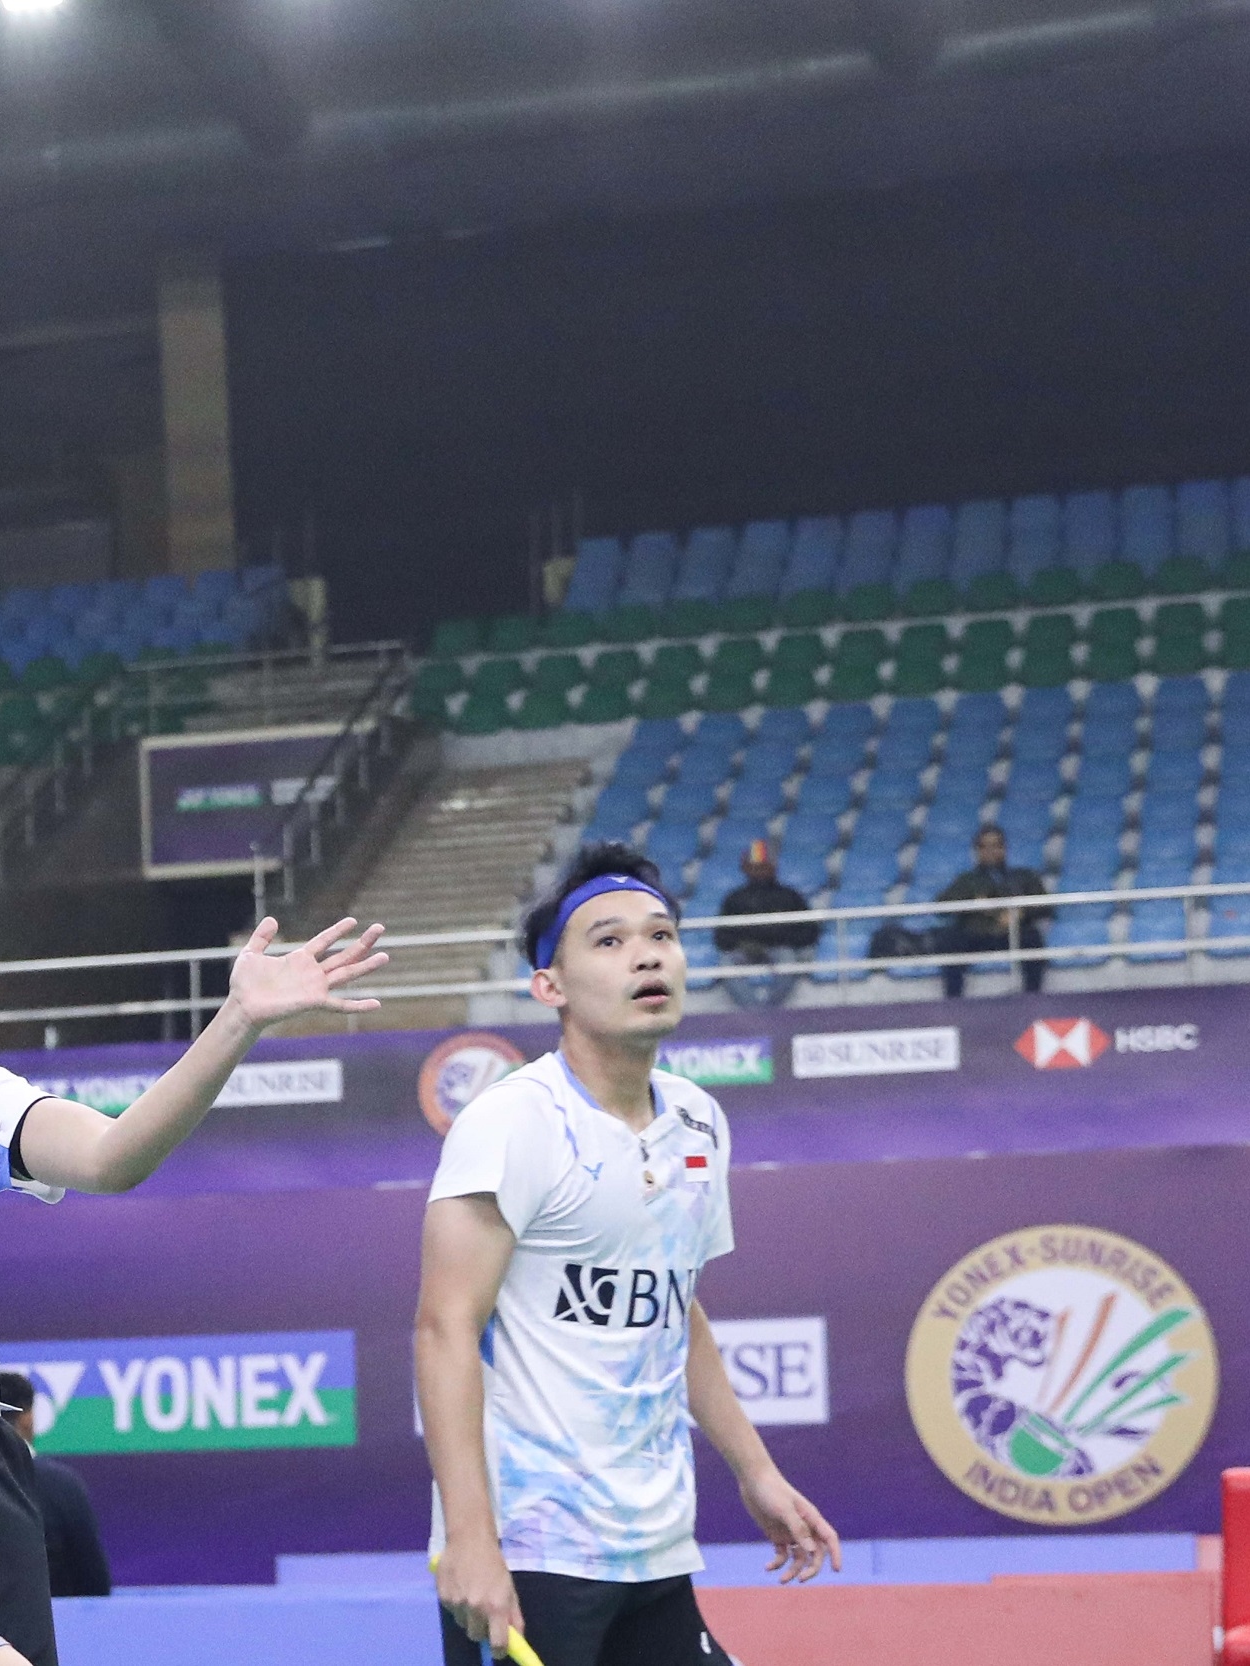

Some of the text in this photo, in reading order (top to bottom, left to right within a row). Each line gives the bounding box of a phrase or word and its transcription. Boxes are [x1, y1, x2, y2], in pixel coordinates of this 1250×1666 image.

[665, 1043, 761, 1078] YONEX
[828, 1036, 946, 1065] SUNRISE
[1114, 1023, 1200, 1053] HSBC
[624, 1268, 699, 1329] BN
[98, 1351, 328, 1433] YONEX
[963, 1453, 1165, 1513] INDIA OPEN
